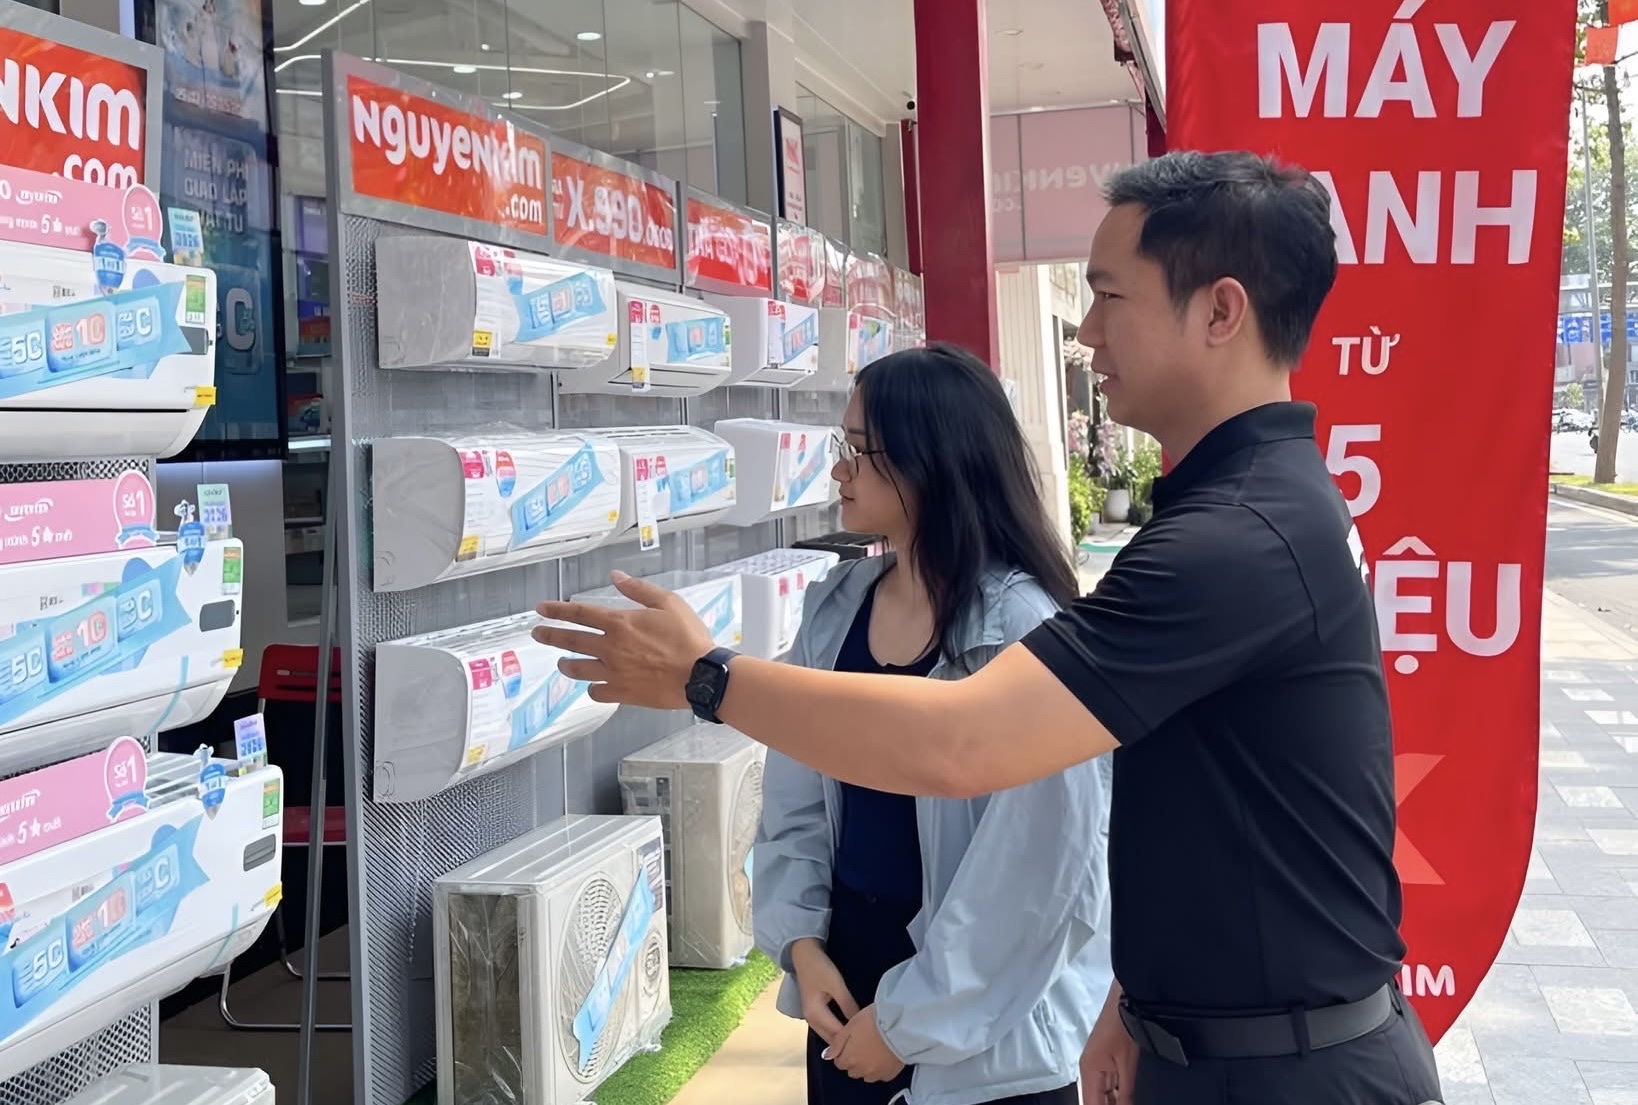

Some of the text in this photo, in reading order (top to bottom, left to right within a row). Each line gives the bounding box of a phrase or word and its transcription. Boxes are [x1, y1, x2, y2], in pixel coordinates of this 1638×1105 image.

[1257, 0, 1517, 118] MÁY
[505, 193, 542, 224] .com
[1332, 326, 1400, 376] TỪ
[1325, 424, 1382, 518] 5
[1374, 536, 1521, 674] ỆU
[1401, 964, 1456, 997] IM
